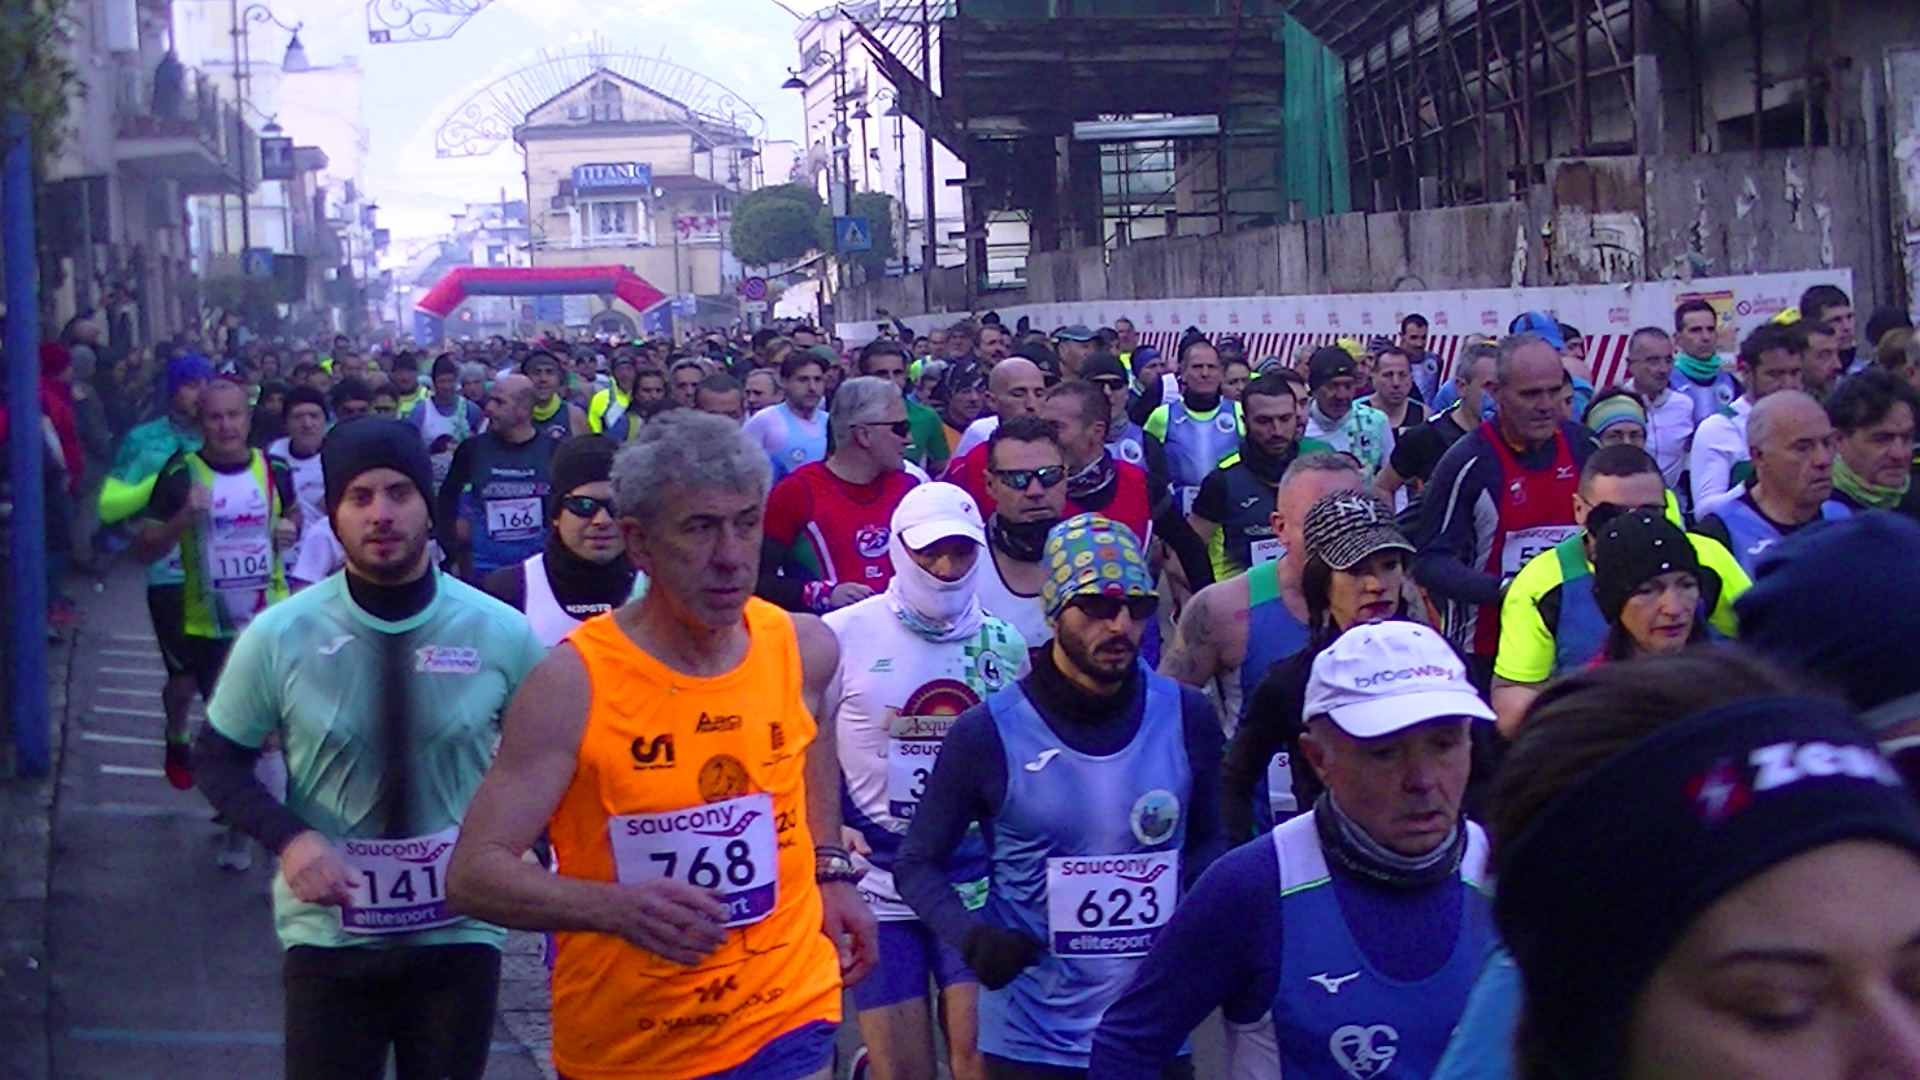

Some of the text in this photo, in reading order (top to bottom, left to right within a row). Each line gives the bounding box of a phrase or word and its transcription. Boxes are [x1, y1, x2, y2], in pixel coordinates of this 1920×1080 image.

[579, 164, 648, 179] TITANIC
[500, 511, 533, 528] 166
[1334, 496, 1378, 523] NY
[219, 555, 267, 576] 1104
[910, 767, 929, 799] 3
[627, 804, 735, 836] saucony
[346, 840, 430, 857] saucony
[650, 839, 756, 888] 768
[1062, 858, 1151, 876] saucony
[362, 865, 439, 905] 141
[354, 908, 437, 926] elitesport
[1077, 886, 1160, 928] 623
[1068, 933, 1153, 952] elitesport
